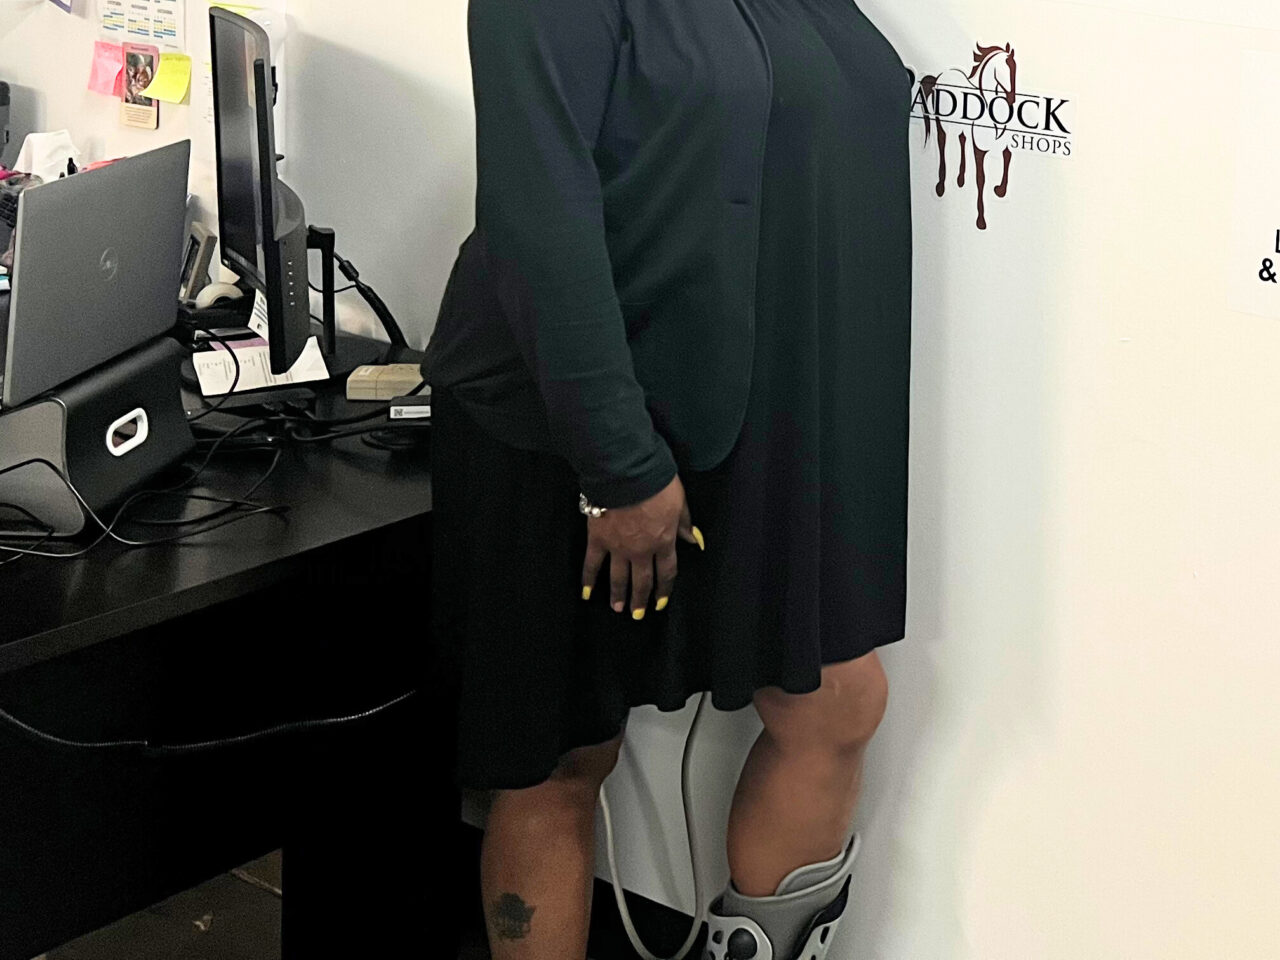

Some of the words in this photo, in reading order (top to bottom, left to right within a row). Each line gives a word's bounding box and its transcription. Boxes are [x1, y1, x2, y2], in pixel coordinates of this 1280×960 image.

[910, 85, 1071, 134] ADDOCK
[1011, 133, 1071, 156] SHOPS
[1258, 258, 1278, 284] &
